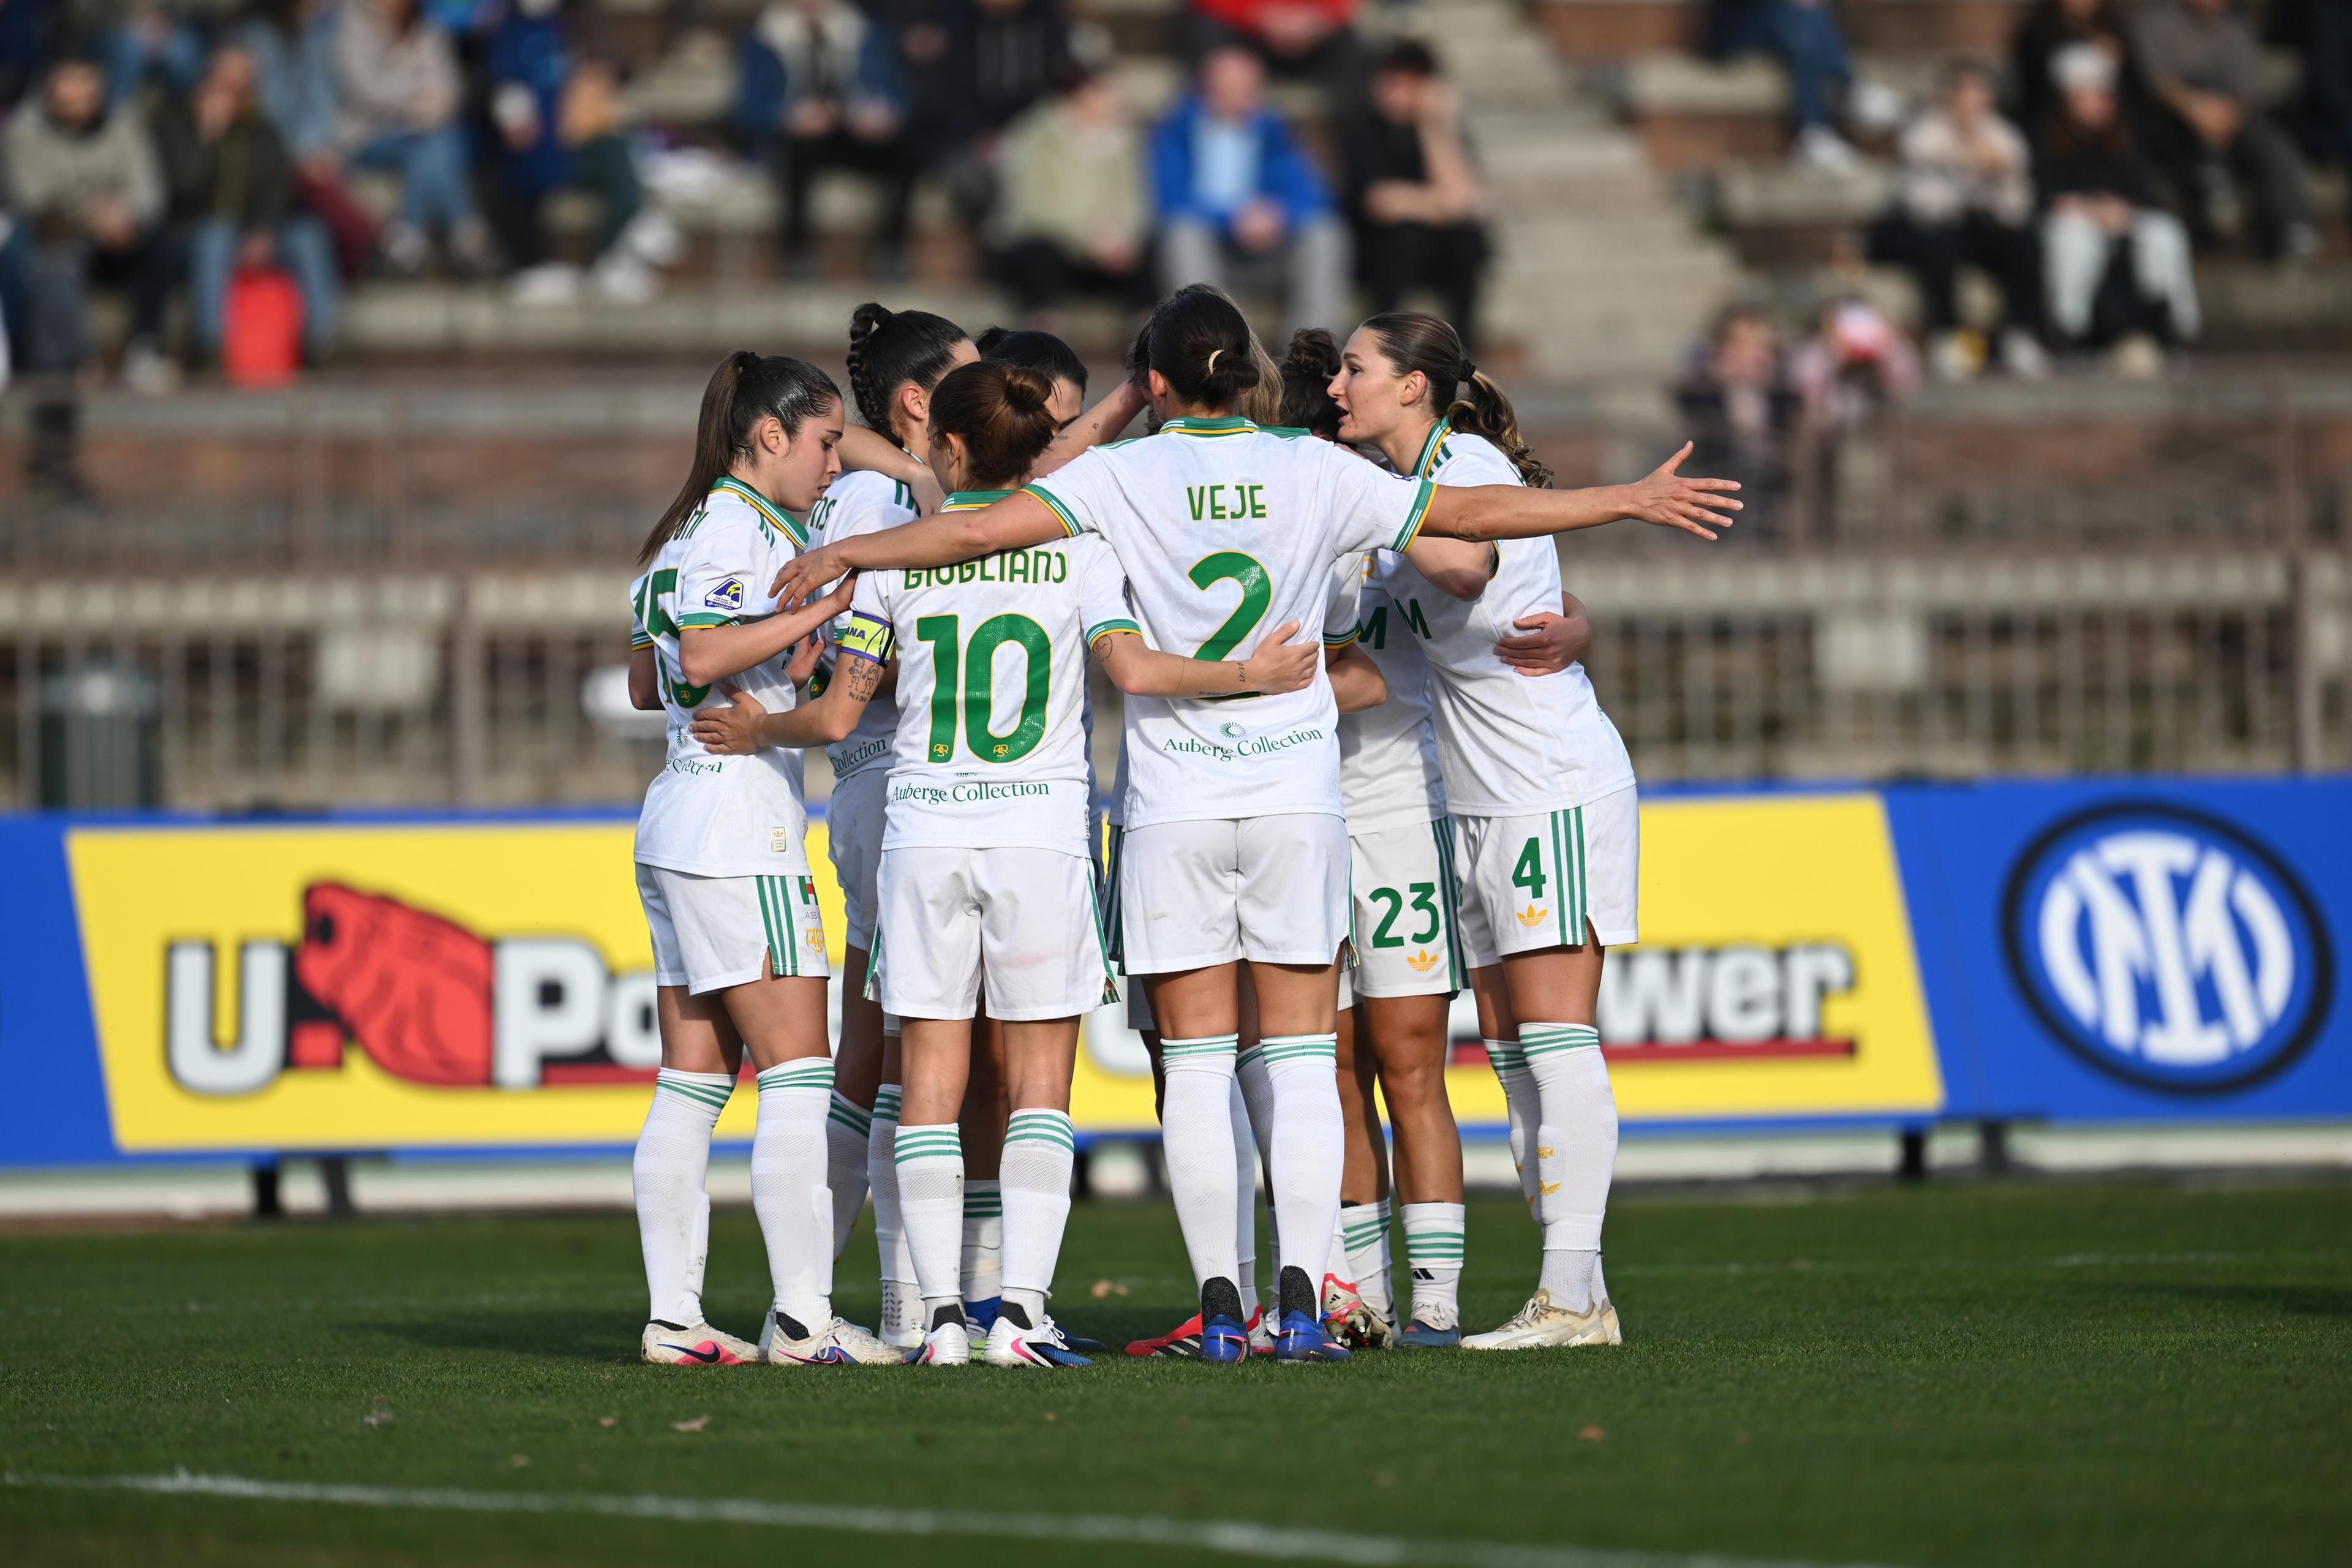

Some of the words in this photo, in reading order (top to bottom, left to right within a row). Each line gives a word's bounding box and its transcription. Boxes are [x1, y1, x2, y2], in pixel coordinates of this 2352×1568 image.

[1186, 484, 1267, 521] VEJE
[1188, 550, 1273, 701] 2
[916, 613, 1052, 763] 10
[829, 739, 886, 772] Collection
[1163, 738, 1237, 762] Auberge
[1237, 729, 1323, 756] Collection
[891, 783, 948, 805] Auberge
[952, 782, 1050, 802] Collection
[1512, 837, 1546, 899] 4
[1368, 882, 1439, 949] 23
